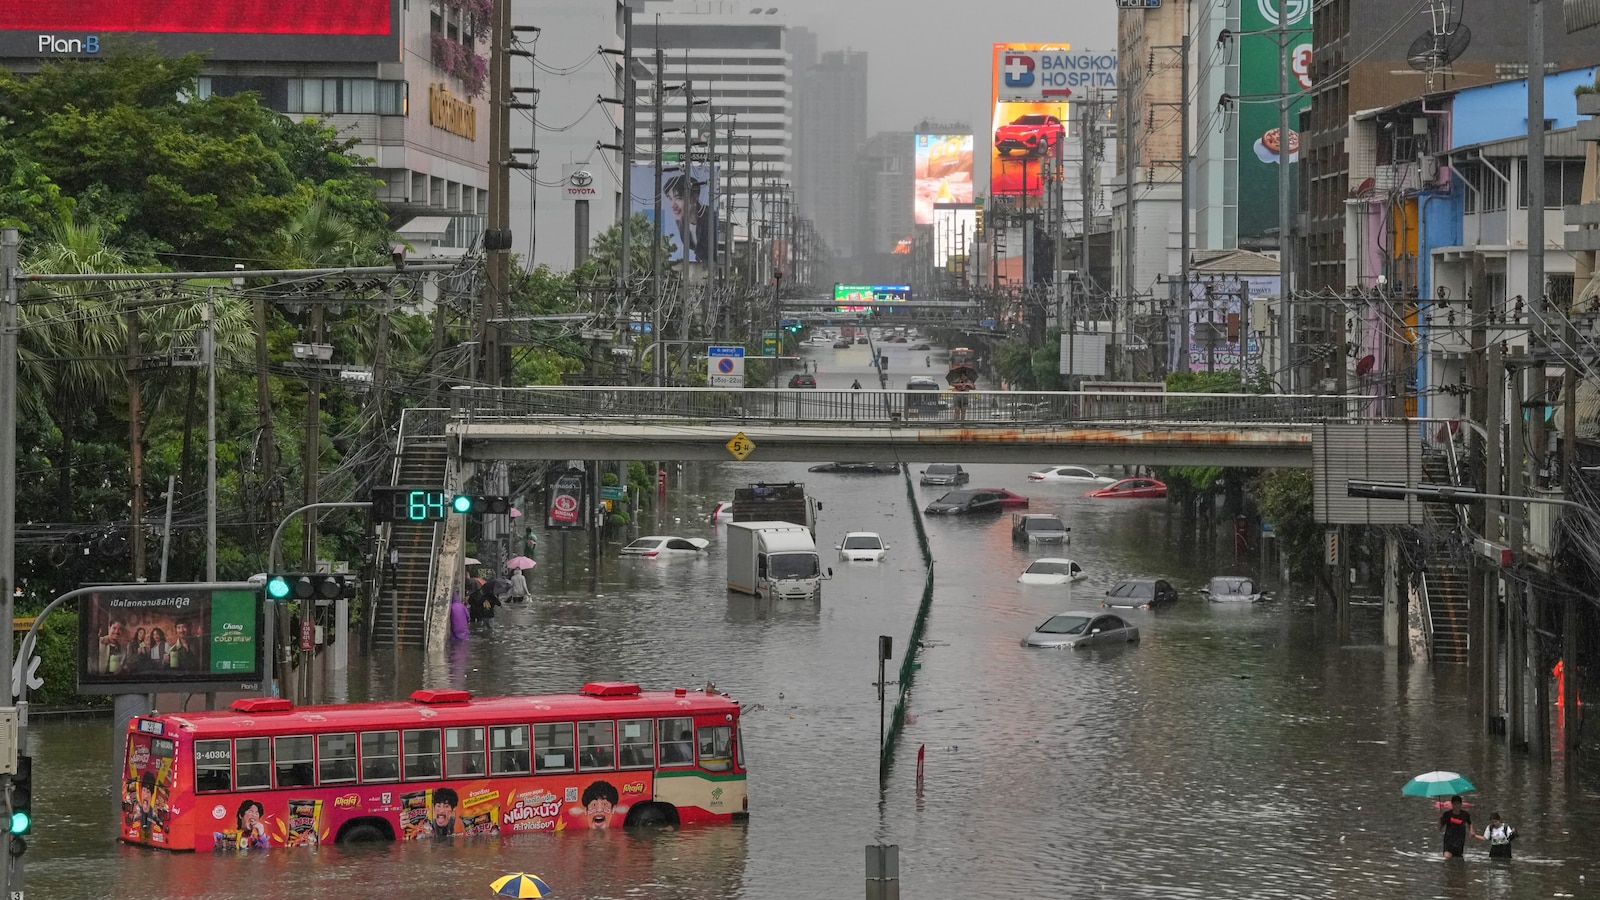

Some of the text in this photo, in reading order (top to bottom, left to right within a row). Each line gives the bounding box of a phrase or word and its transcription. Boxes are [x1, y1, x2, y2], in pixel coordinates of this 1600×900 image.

[1041, 72, 1117, 86] HOSPITA
[409, 491, 443, 520] 64
[554, 509, 574, 518] SINGHA
[222, 622, 244, 631] Chang
